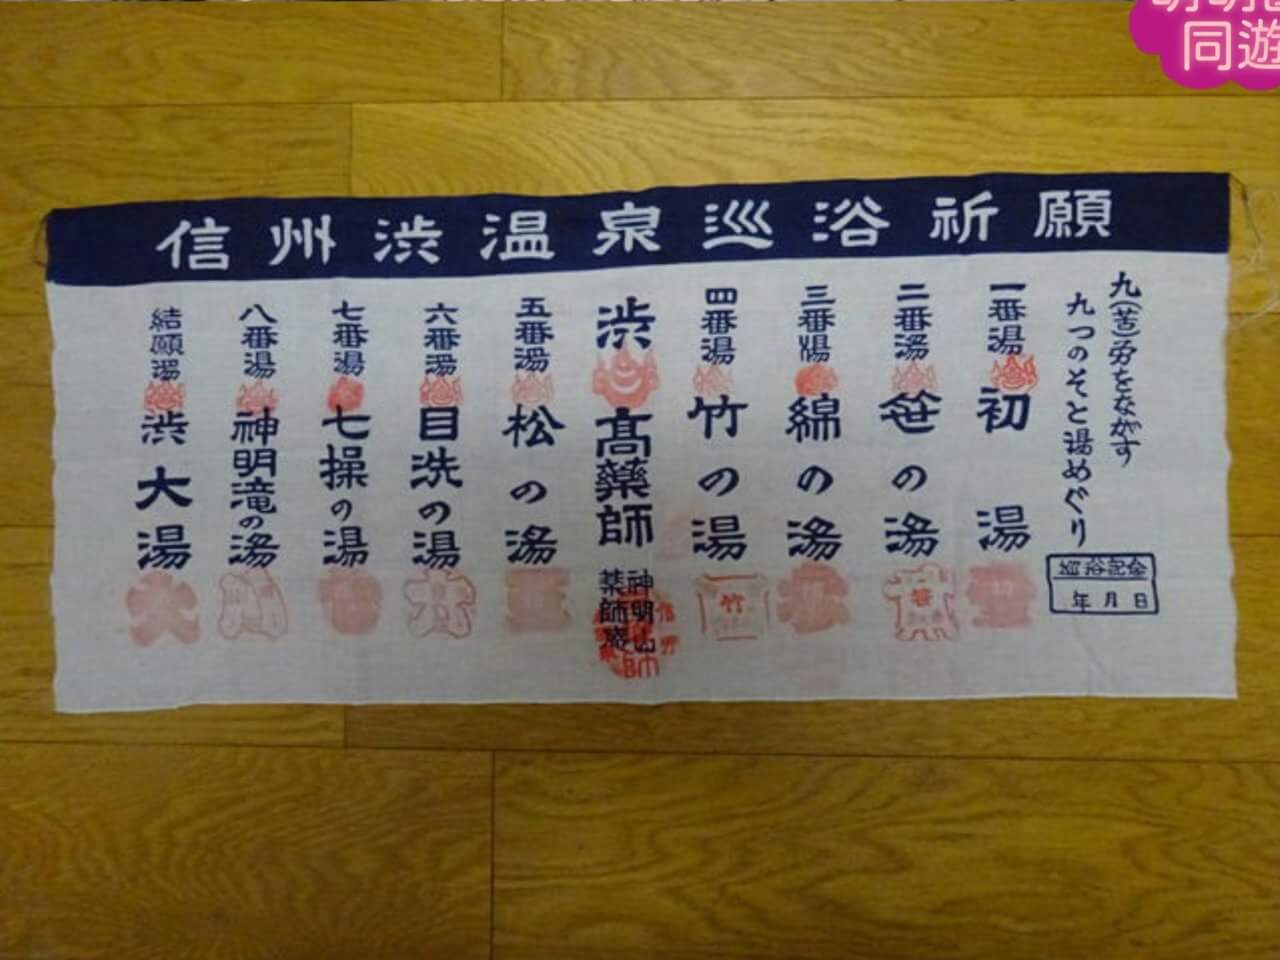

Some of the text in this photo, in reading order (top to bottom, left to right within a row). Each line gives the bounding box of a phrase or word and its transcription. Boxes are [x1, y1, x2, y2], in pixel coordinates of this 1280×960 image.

[155, 189, 1112, 270] 信州渋温泉巡浴祈願
[894, 283, 932, 361] 二番湯
[987, 283, 1027, 355] 一番湯
[228, 303, 280, 569] 八番湯 神明滝の湯
[319, 300, 372, 568] 七番湯 七操の湯
[409, 302, 464, 569] 六番湯 目洗の湯
[501, 297, 566, 566] 五番湯 松の湯
[687, 287, 749, 562] 四番湯 竹の湯
[785, 285, 843, 562] 三番湯 綿の湯
[878, 389, 943, 558] 笹の湯
